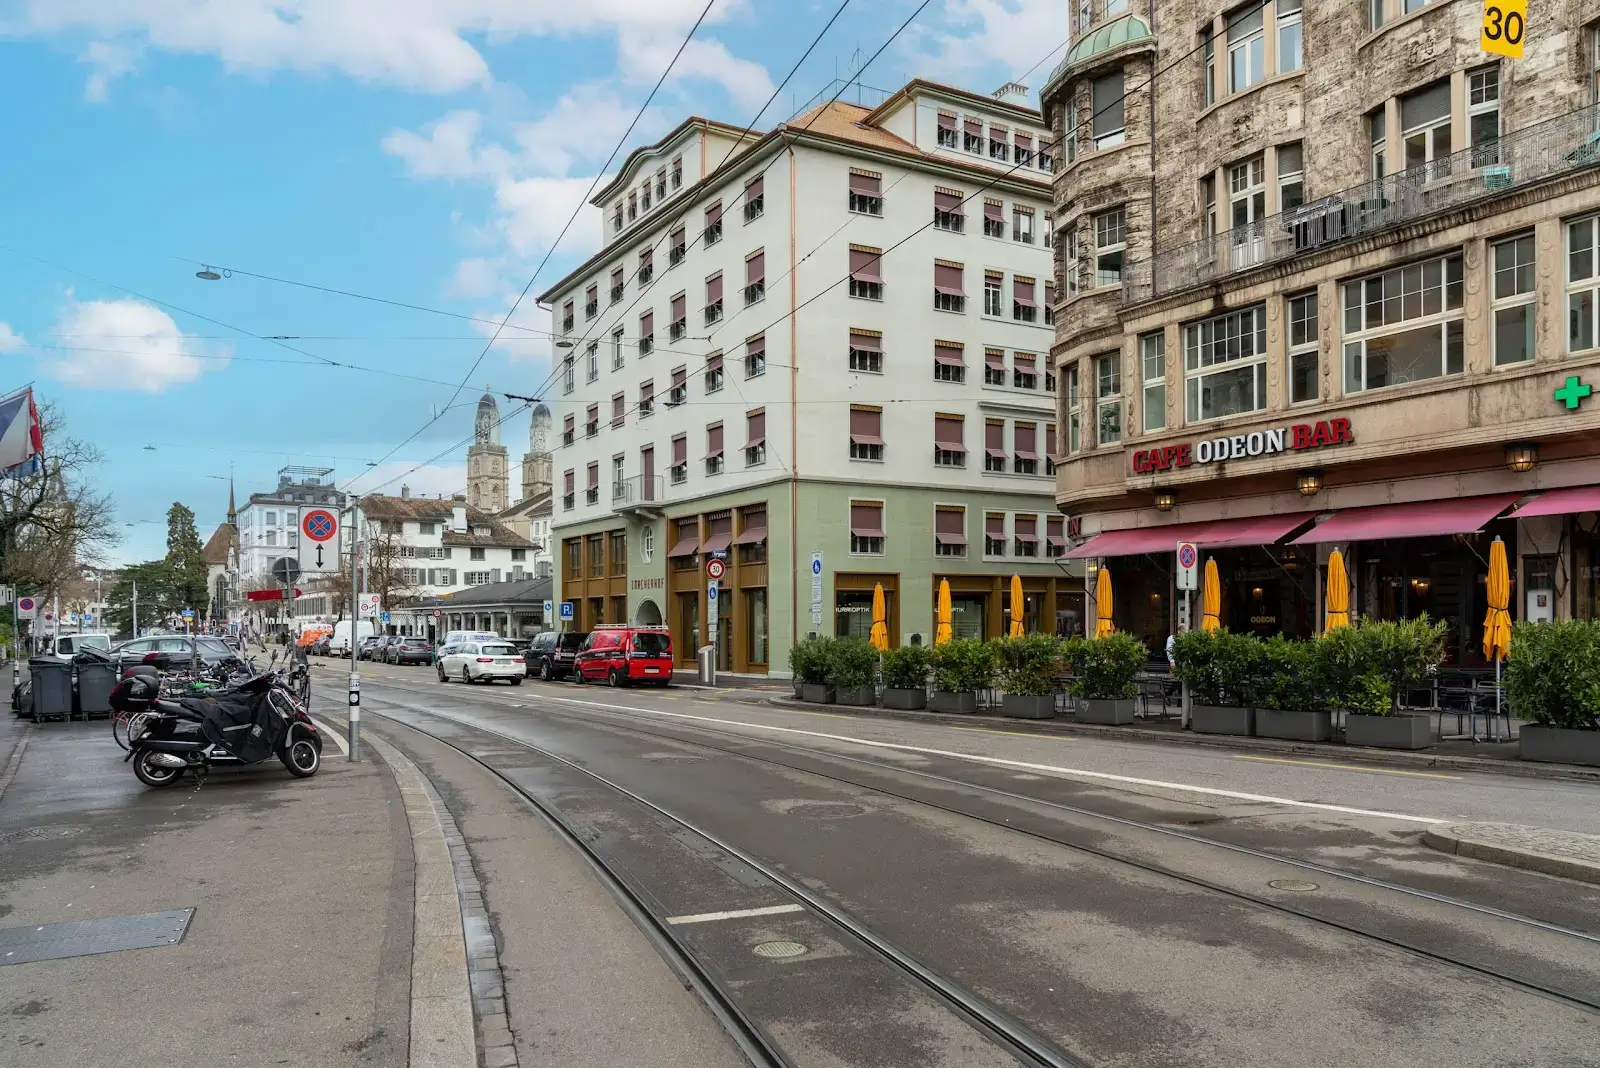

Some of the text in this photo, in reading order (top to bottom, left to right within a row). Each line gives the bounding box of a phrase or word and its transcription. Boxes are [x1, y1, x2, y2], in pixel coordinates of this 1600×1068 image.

[1484, 6, 1524, 45] 30
[1132, 417, 1352, 473] CAFE ODEON BAR
[712, 565, 720, 574] 30
[1250, 616, 1276, 624] ODEON
